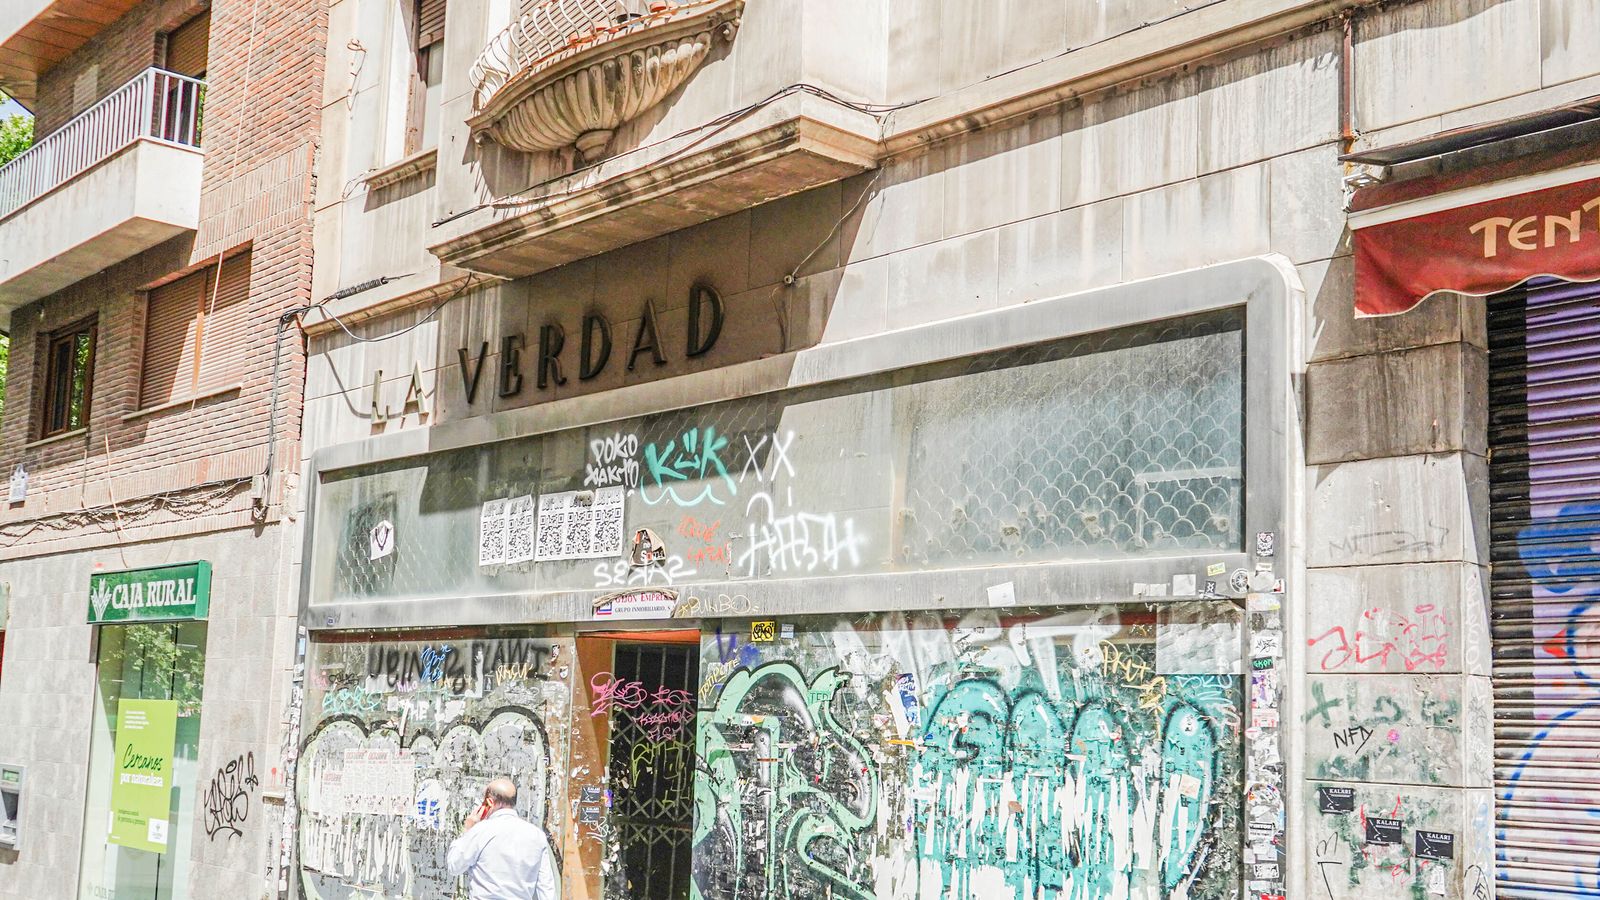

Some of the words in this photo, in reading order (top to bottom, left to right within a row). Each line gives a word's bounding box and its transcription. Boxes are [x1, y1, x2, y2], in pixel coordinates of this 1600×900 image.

[371, 359, 430, 426] LA
[457, 282, 725, 404] VERDAD
[112, 583, 145, 610] CAJA
[146, 578, 197, 607] RURAL
[123, 743, 164, 772] Cercanos
[1376, 819, 1400, 827] KALARI
[1426, 832, 1451, 840] KALARI
